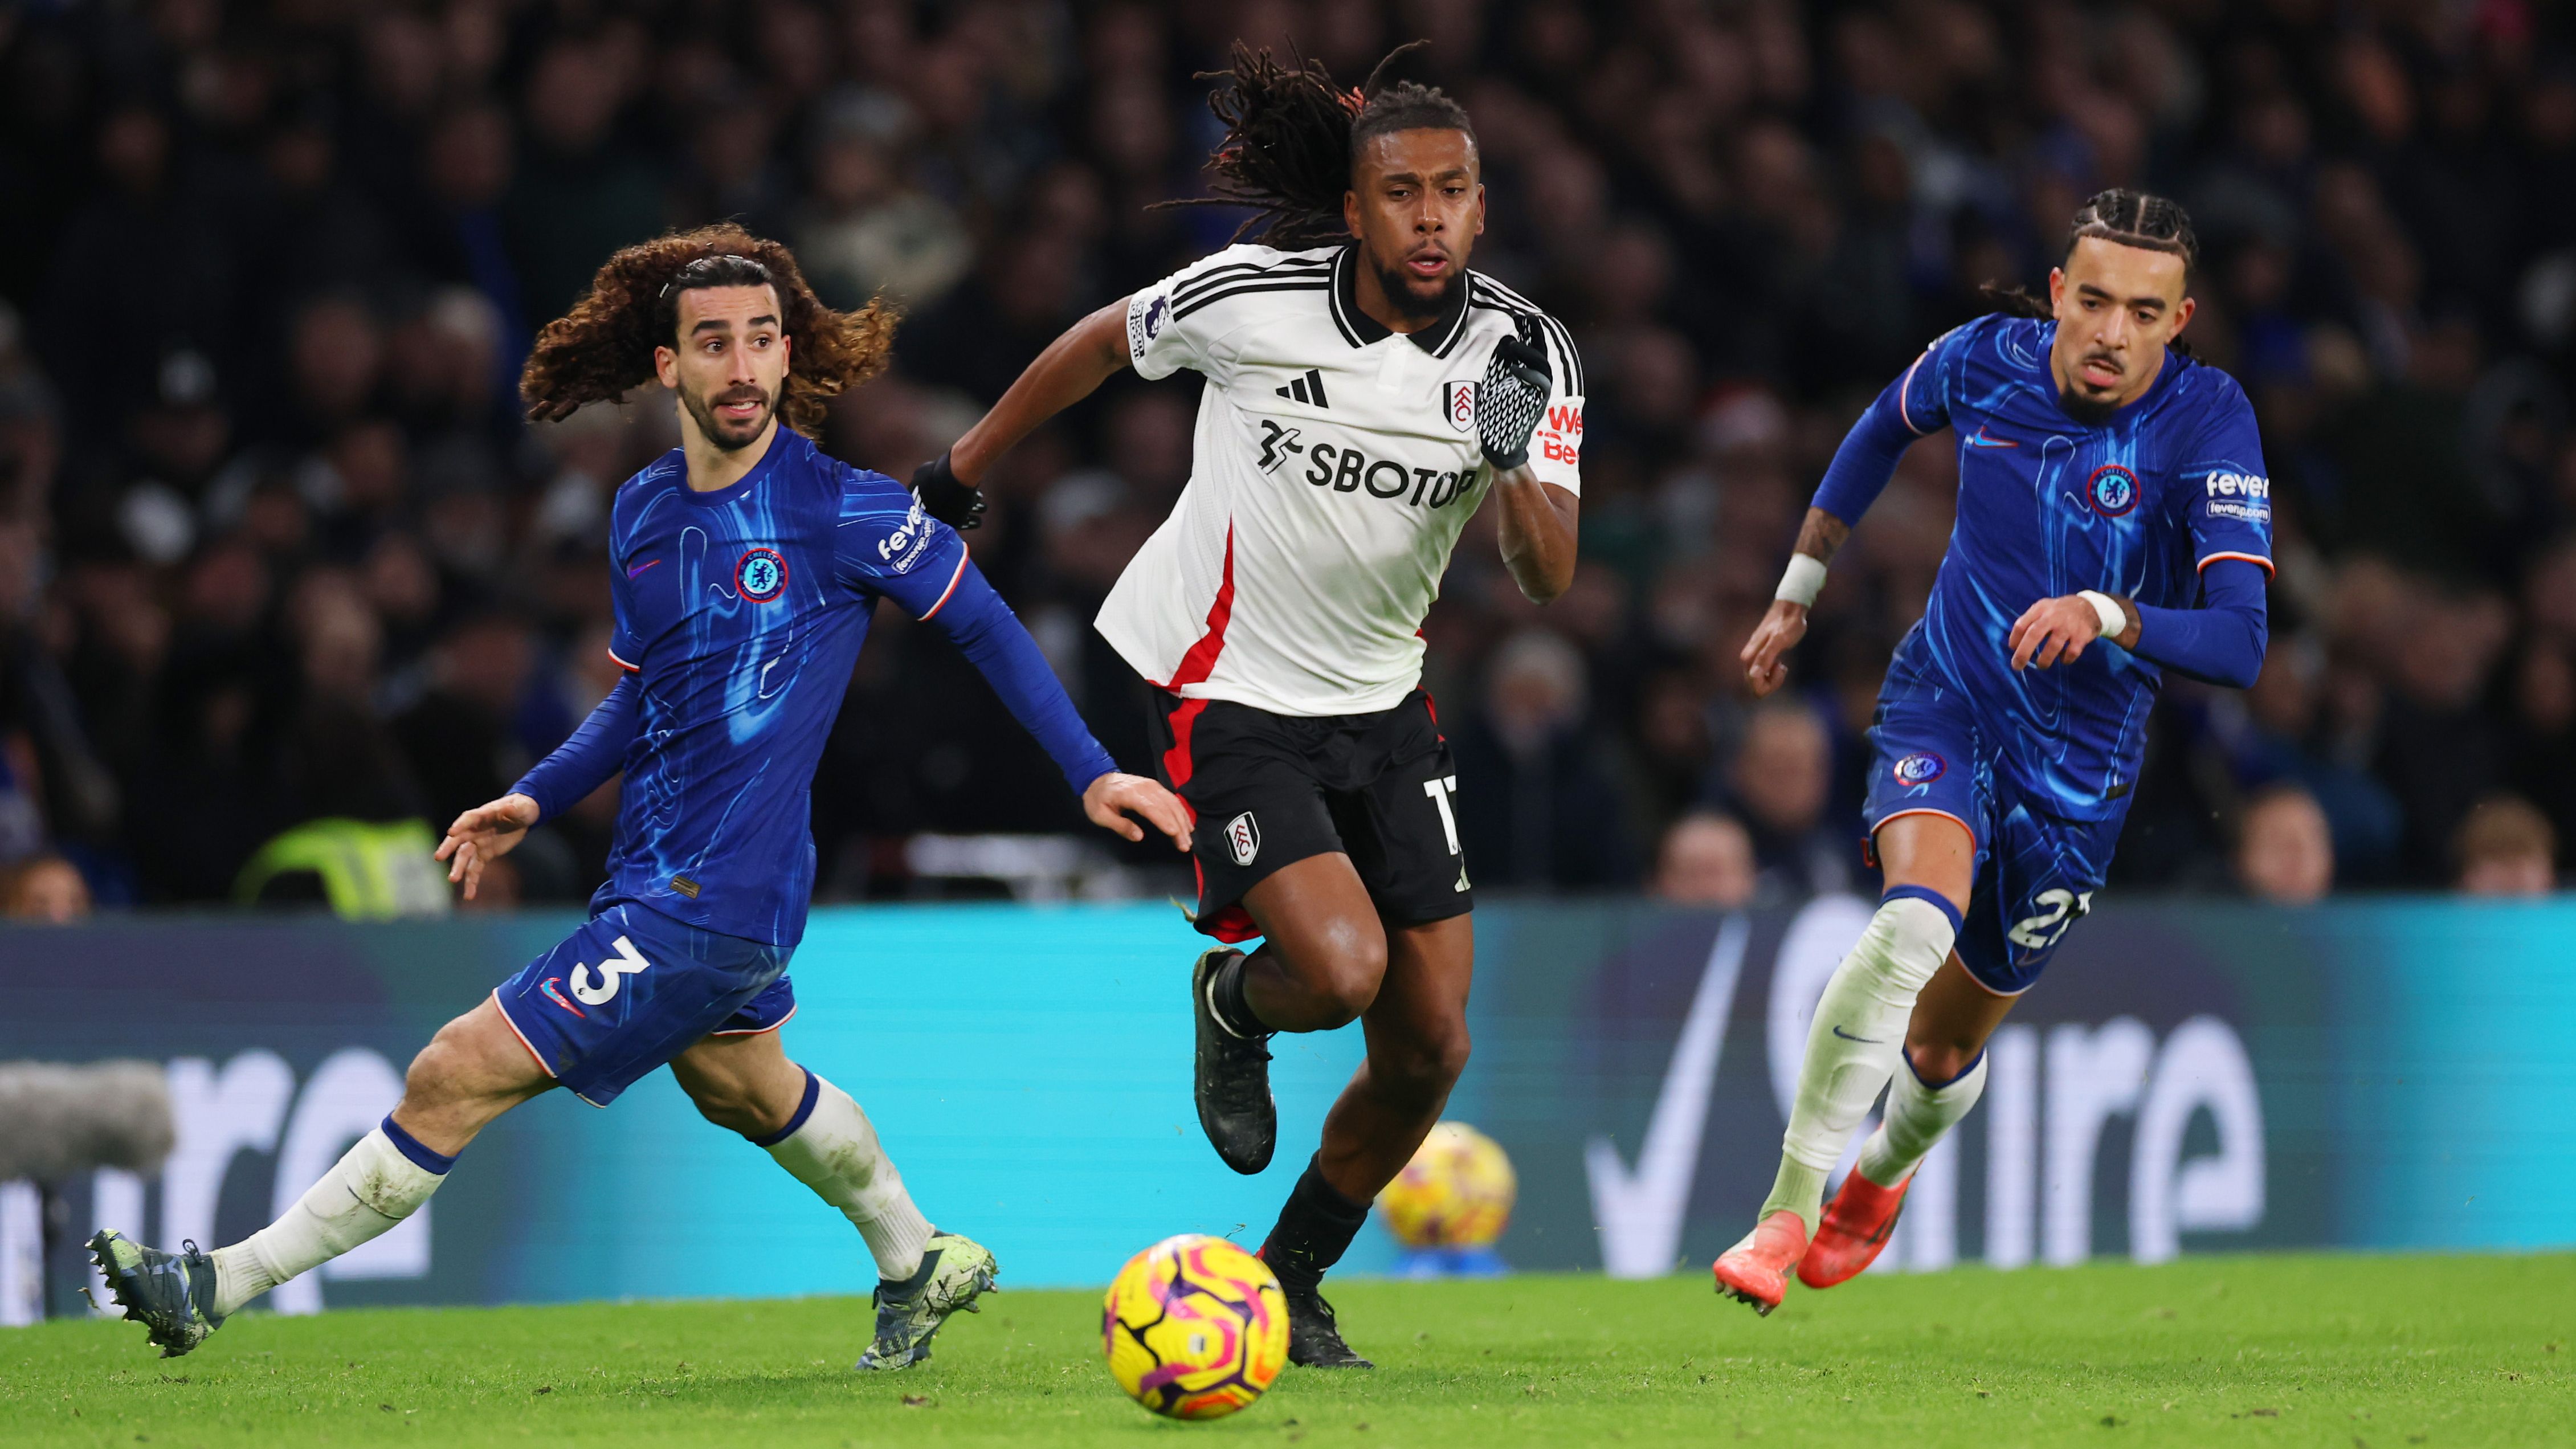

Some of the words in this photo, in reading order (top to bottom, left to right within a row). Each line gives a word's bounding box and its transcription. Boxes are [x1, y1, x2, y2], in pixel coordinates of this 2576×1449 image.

[1136, 317, 1144, 352] room
[1454, 386, 1472, 422] FFC
[1544, 432, 1579, 464] Be
[1306, 443, 1477, 509] SBOTOP
[2206, 471, 2269, 499] fever
[878, 505, 922, 560] feve
[1423, 775, 1459, 855] 1
[1234, 824, 1250, 856] FFC
[570, 935, 651, 1006] 3
